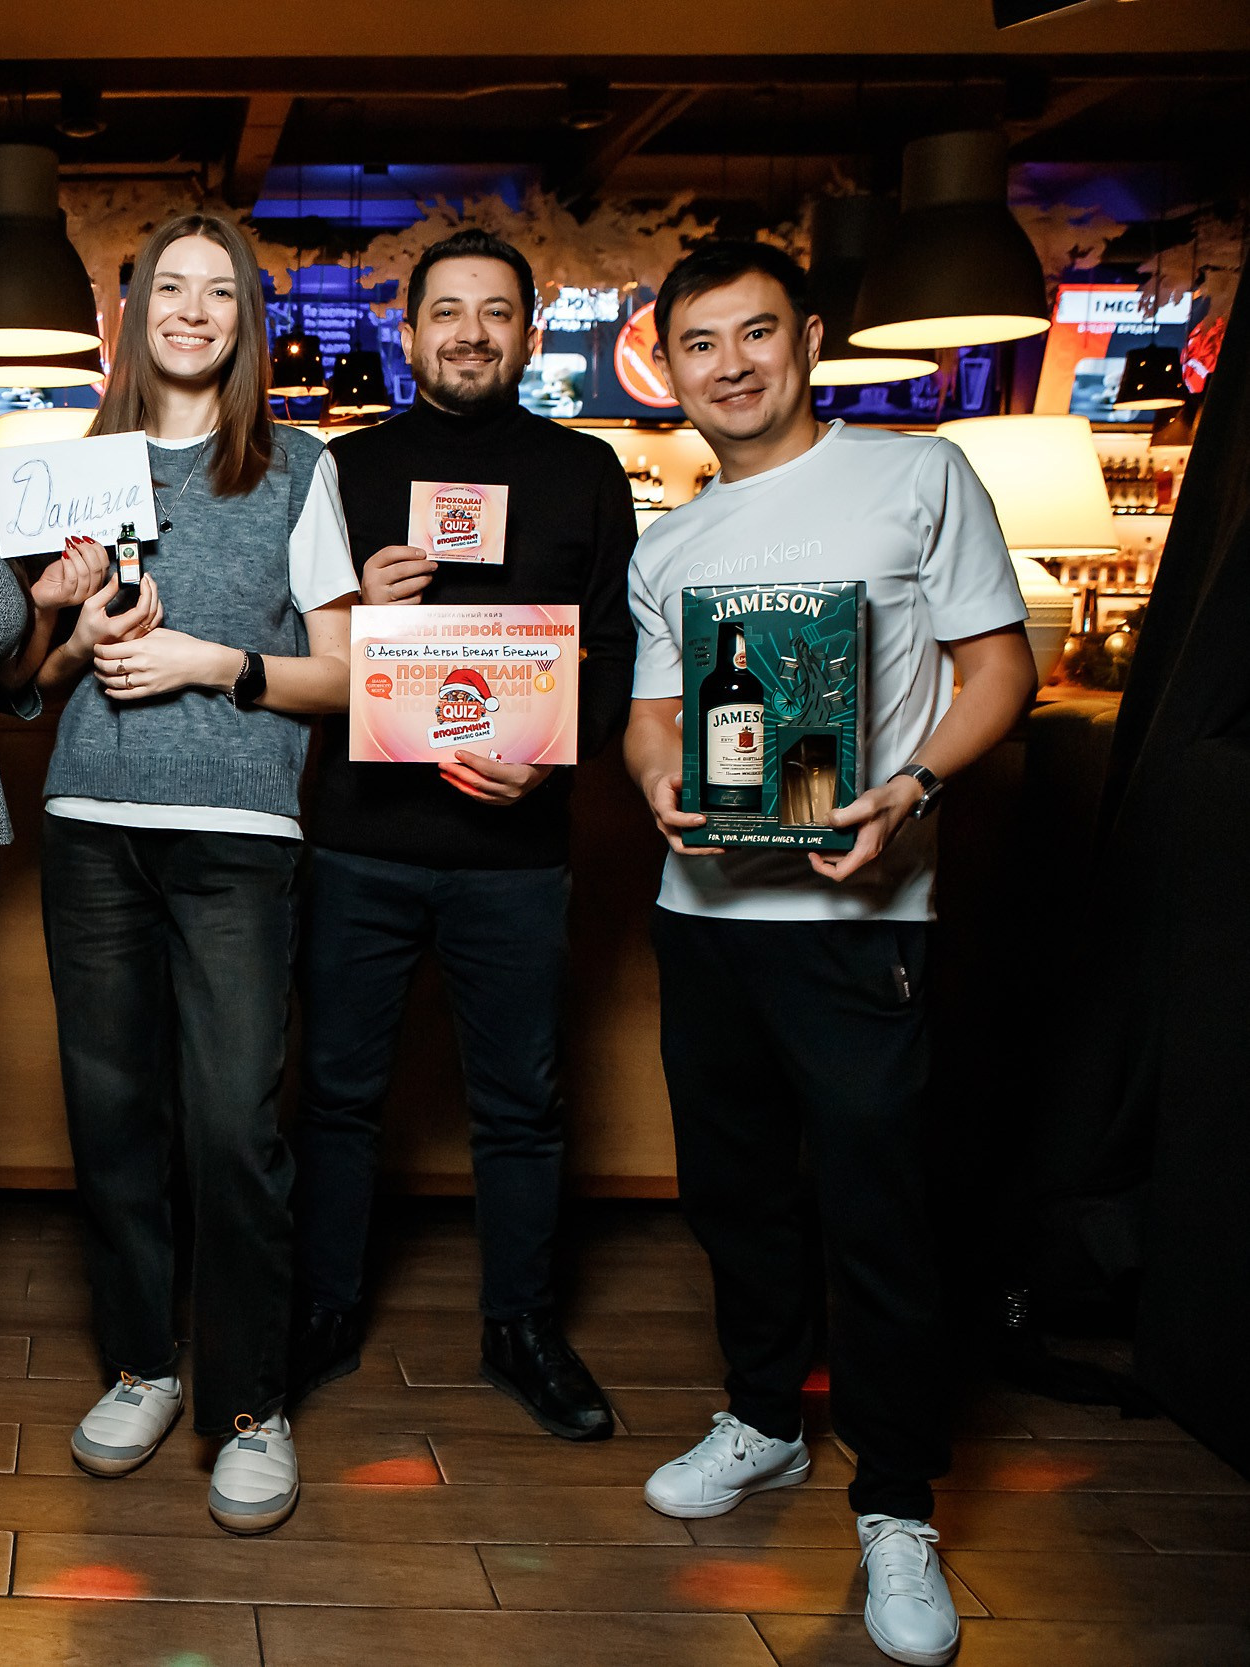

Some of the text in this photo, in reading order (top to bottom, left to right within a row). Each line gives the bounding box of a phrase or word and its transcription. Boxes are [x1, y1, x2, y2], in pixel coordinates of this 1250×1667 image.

[436, 496, 481, 505] ПРОХОДКА!
[444, 520, 470, 531] QUIZ
[687, 537, 823, 582] Calvin Klein
[712, 592, 825, 622] JAMESON
[441, 622, 501, 637] ПЕРВОЙ
[506, 624, 575, 637] СТЕПЕНИ
[366, 645, 376, 658] В
[540, 676, 547, 689] 1
[442, 704, 478, 719] QUIZ
[453, 729, 491, 742] #MUSIC GAME
[708, 833, 720, 841] FOR
[722, 834, 738, 843] YOUR
[740, 834, 771, 843] JAMESON
[771, 835, 796, 843] GINGER
[807, 836, 824, 845] LIME
